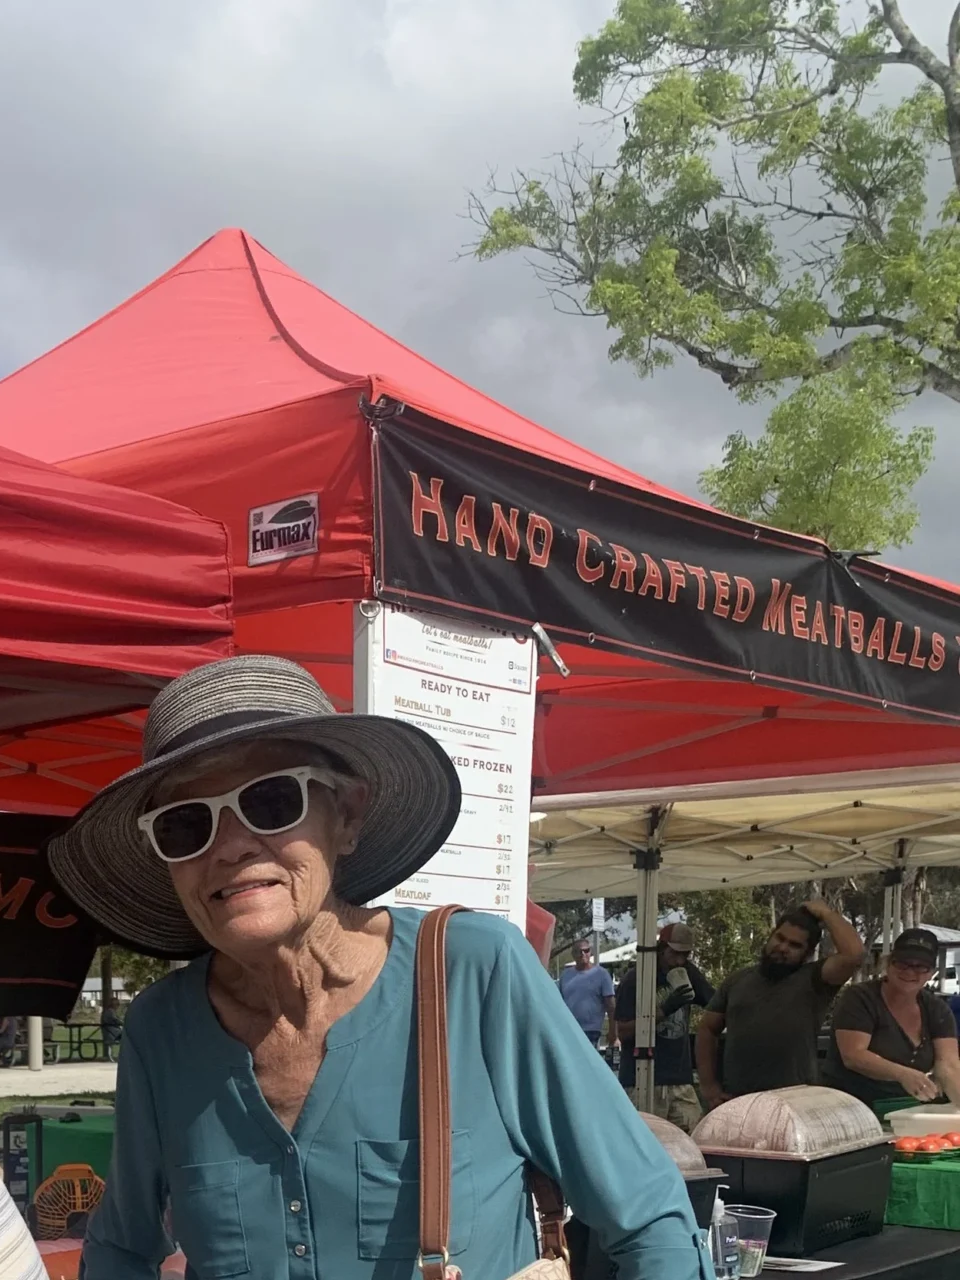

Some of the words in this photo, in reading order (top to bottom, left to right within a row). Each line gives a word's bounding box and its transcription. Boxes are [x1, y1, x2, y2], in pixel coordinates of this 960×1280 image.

[252, 521, 311, 553] Eurmax
[409, 471, 553, 568] HAND
[576, 528, 755, 623] CRAFTED
[762, 578, 946, 672] MEATBALLS
[421, 679, 452, 695] READY
[455, 687, 469, 698] TO
[472, 690, 491, 702] EAT
[394, 695, 433, 714] MEATBALL
[435, 705, 452, 717] TUB
[500, 715, 516, 728] $12
[451, 755, 470, 767] KED
[472, 759, 513, 774] FROZEN
[497, 783, 514, 794] $22
[496, 833, 511, 845] $17
[495, 864, 510, 876] $17
[394, 887, 432, 901] MEATLOAF
